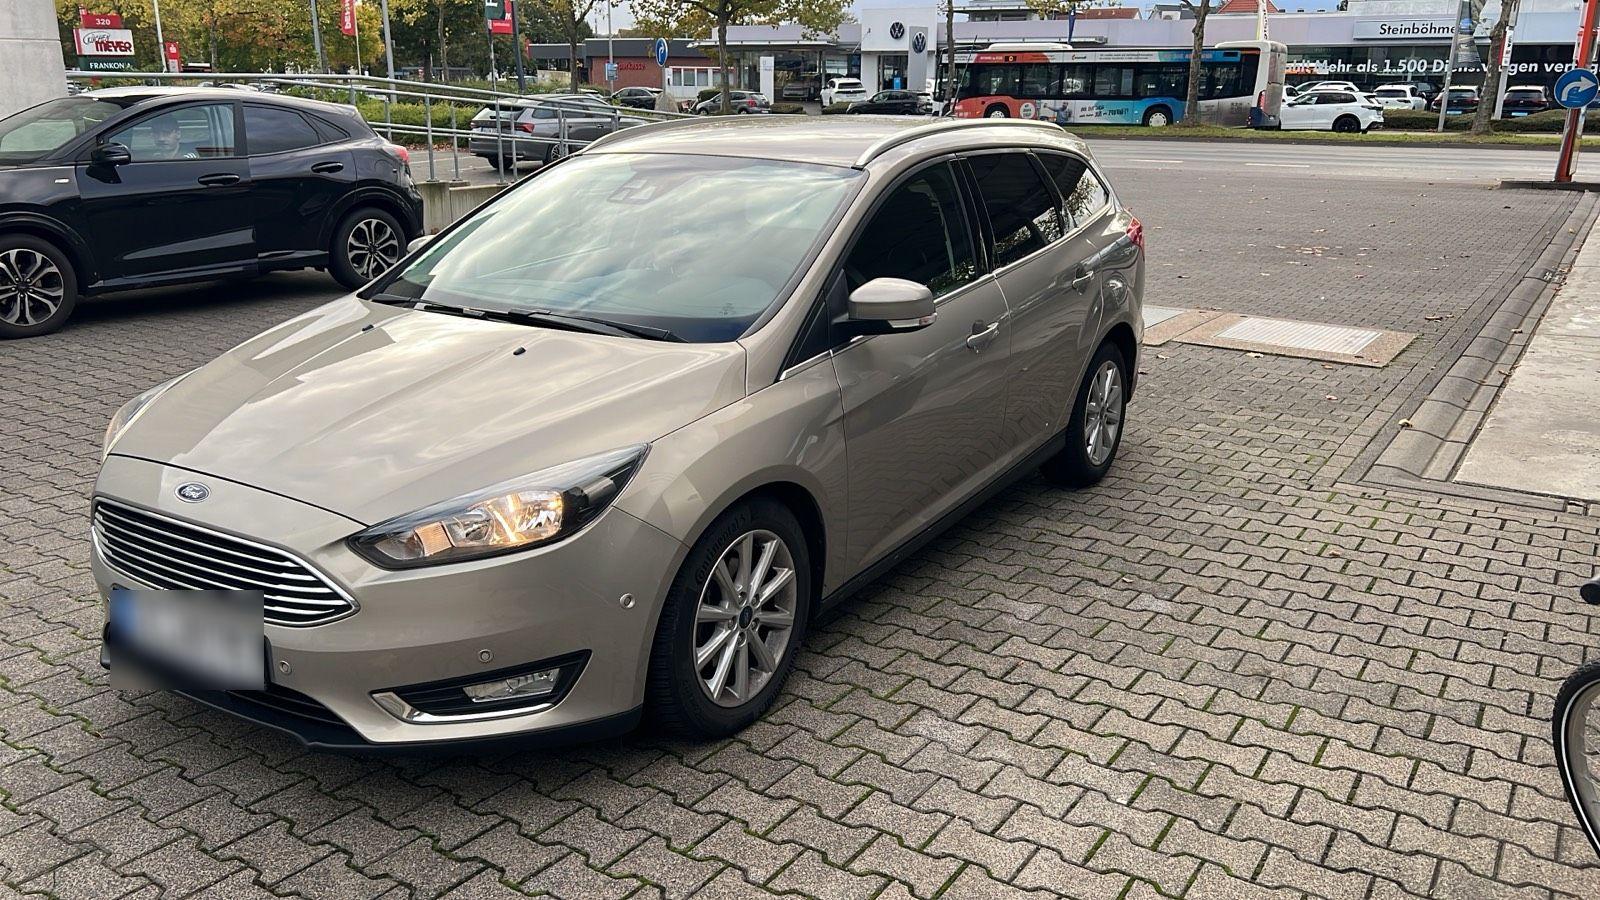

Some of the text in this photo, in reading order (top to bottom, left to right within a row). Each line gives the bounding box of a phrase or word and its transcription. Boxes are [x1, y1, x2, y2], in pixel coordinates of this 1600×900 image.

[95, 18, 111, 26] 320
[1379, 22, 1456, 35] Steinböhme
[95, 40, 132, 53] MEYER
[1315, 58, 1352, 73] Mehr
[1356, 58, 1379, 73] als
[1383, 58, 1428, 73] 1.500
[180, 484, 204, 499] Ford
